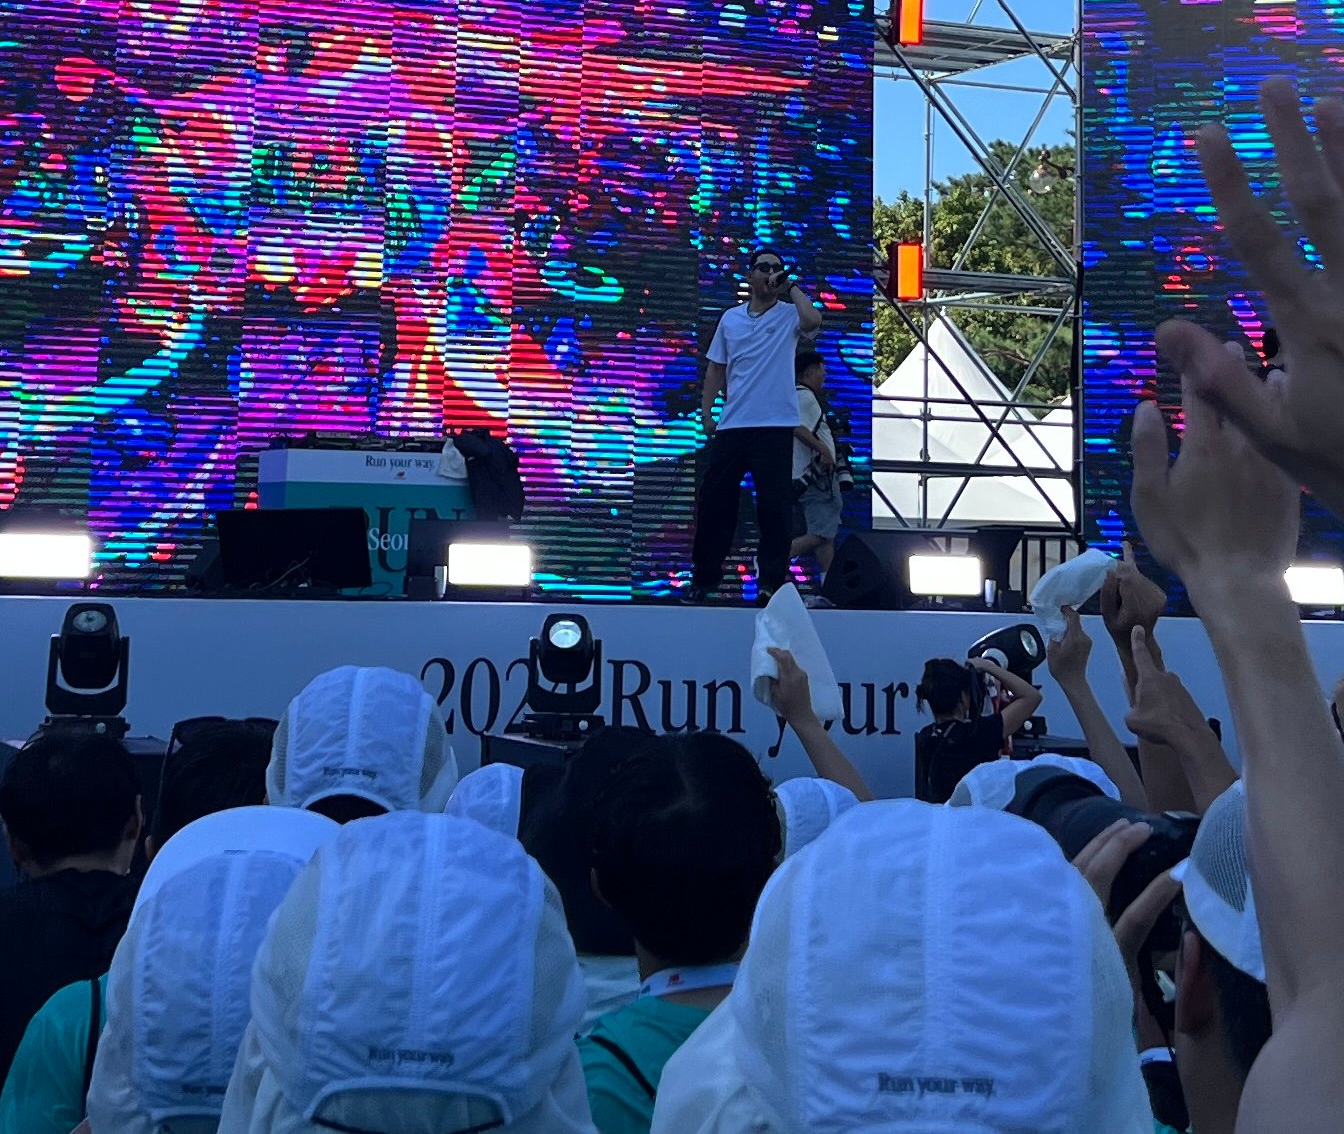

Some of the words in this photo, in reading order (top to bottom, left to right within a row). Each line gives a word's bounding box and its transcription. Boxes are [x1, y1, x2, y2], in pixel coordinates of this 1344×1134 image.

[365, 454, 387, 467] Run
[389, 456, 413, 471] your
[368, 527, 408, 552] Seo
[421, 657, 578, 735] 202
[606, 659, 746, 734] Run
[878, 1071, 915, 1092] Run
